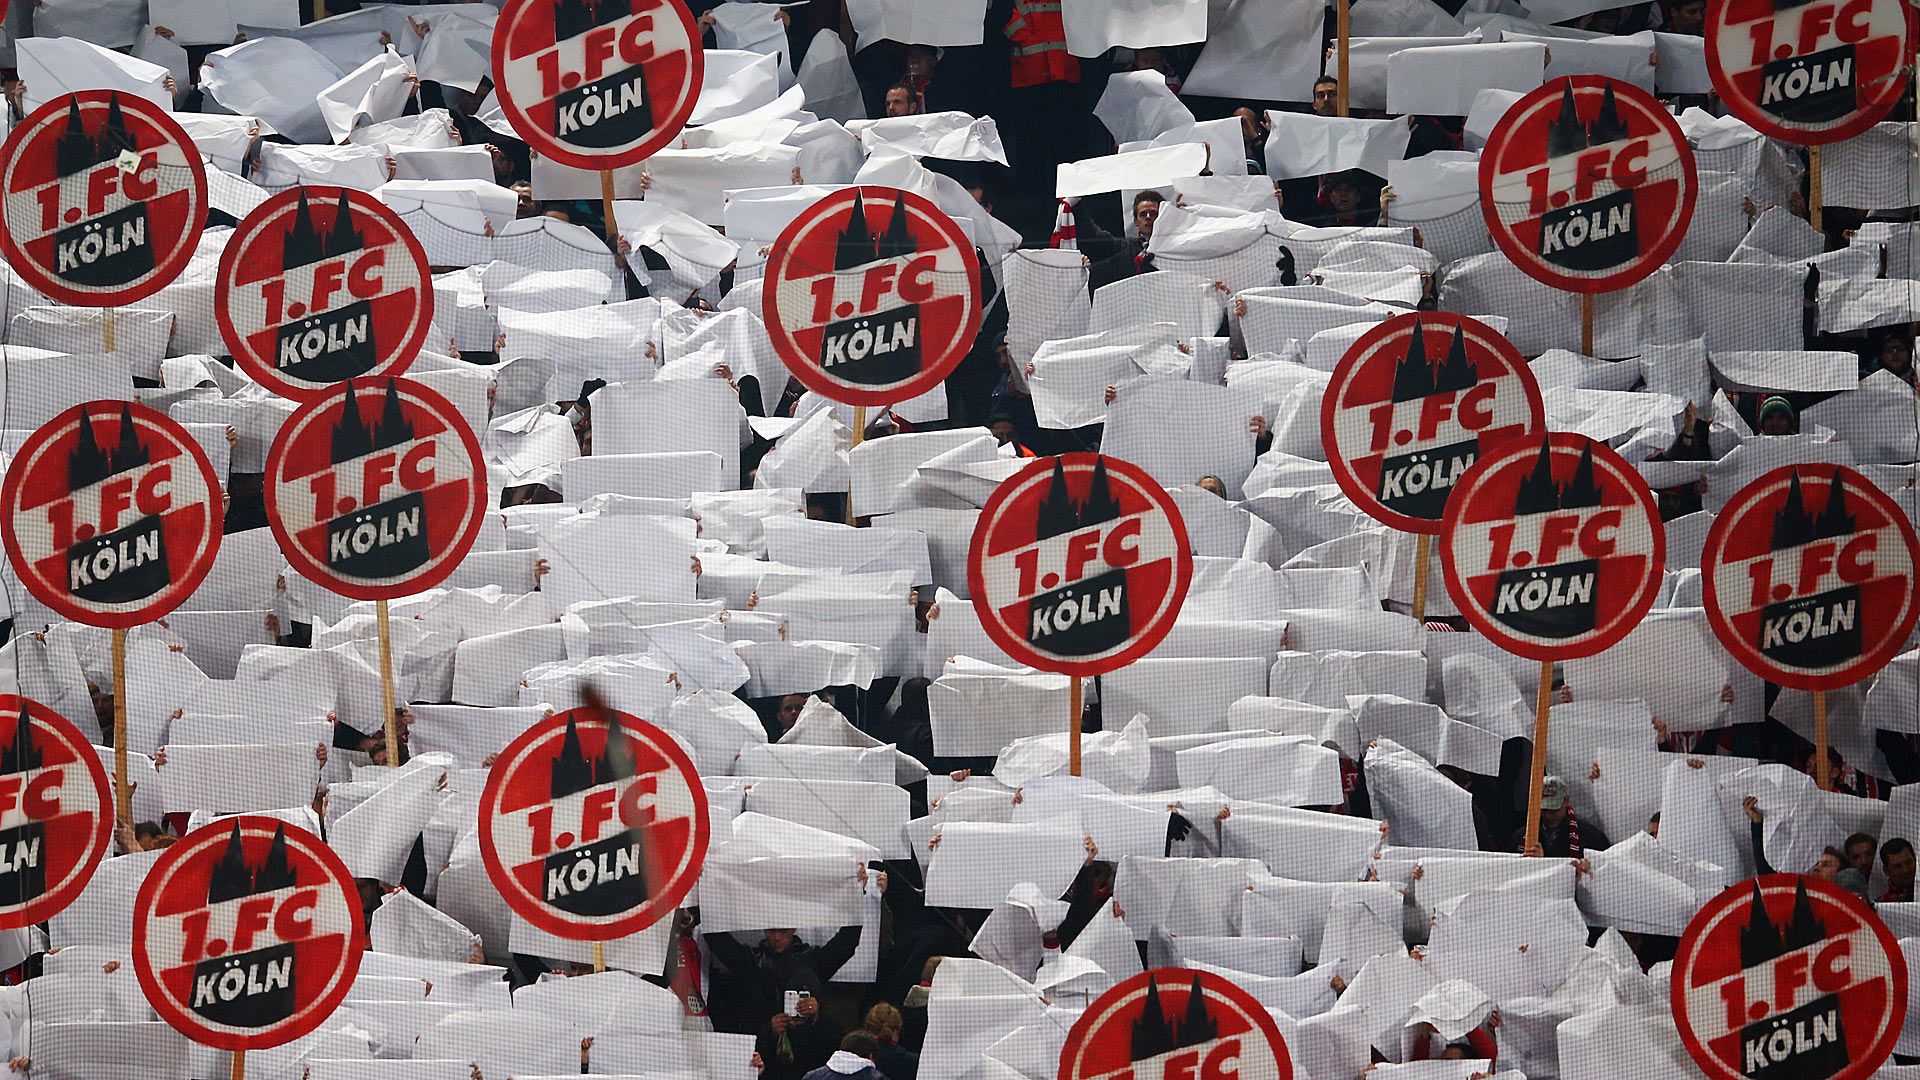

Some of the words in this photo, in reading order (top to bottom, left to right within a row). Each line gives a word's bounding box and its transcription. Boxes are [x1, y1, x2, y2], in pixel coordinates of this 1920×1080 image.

[559, 78, 643, 138] KÖLN
[1761, 58, 1851, 106] KÖLN
[58, 218, 145, 274] KÖLN
[1543, 203, 1632, 255] KÖLN
[280, 315, 368, 367] KÖLN
[824, 318, 915, 366] KÖLN
[71, 529, 159, 590] KÖLN
[331, 506, 419, 562] KÖLN
[1031, 586, 1122, 640] KÖLN
[1496, 572, 1595, 615] KÖLN
[547, 844, 639, 900] KÖLN
[194, 957, 292, 1008] KÖLN
[1745, 1010, 1837, 1073] KÖLN
